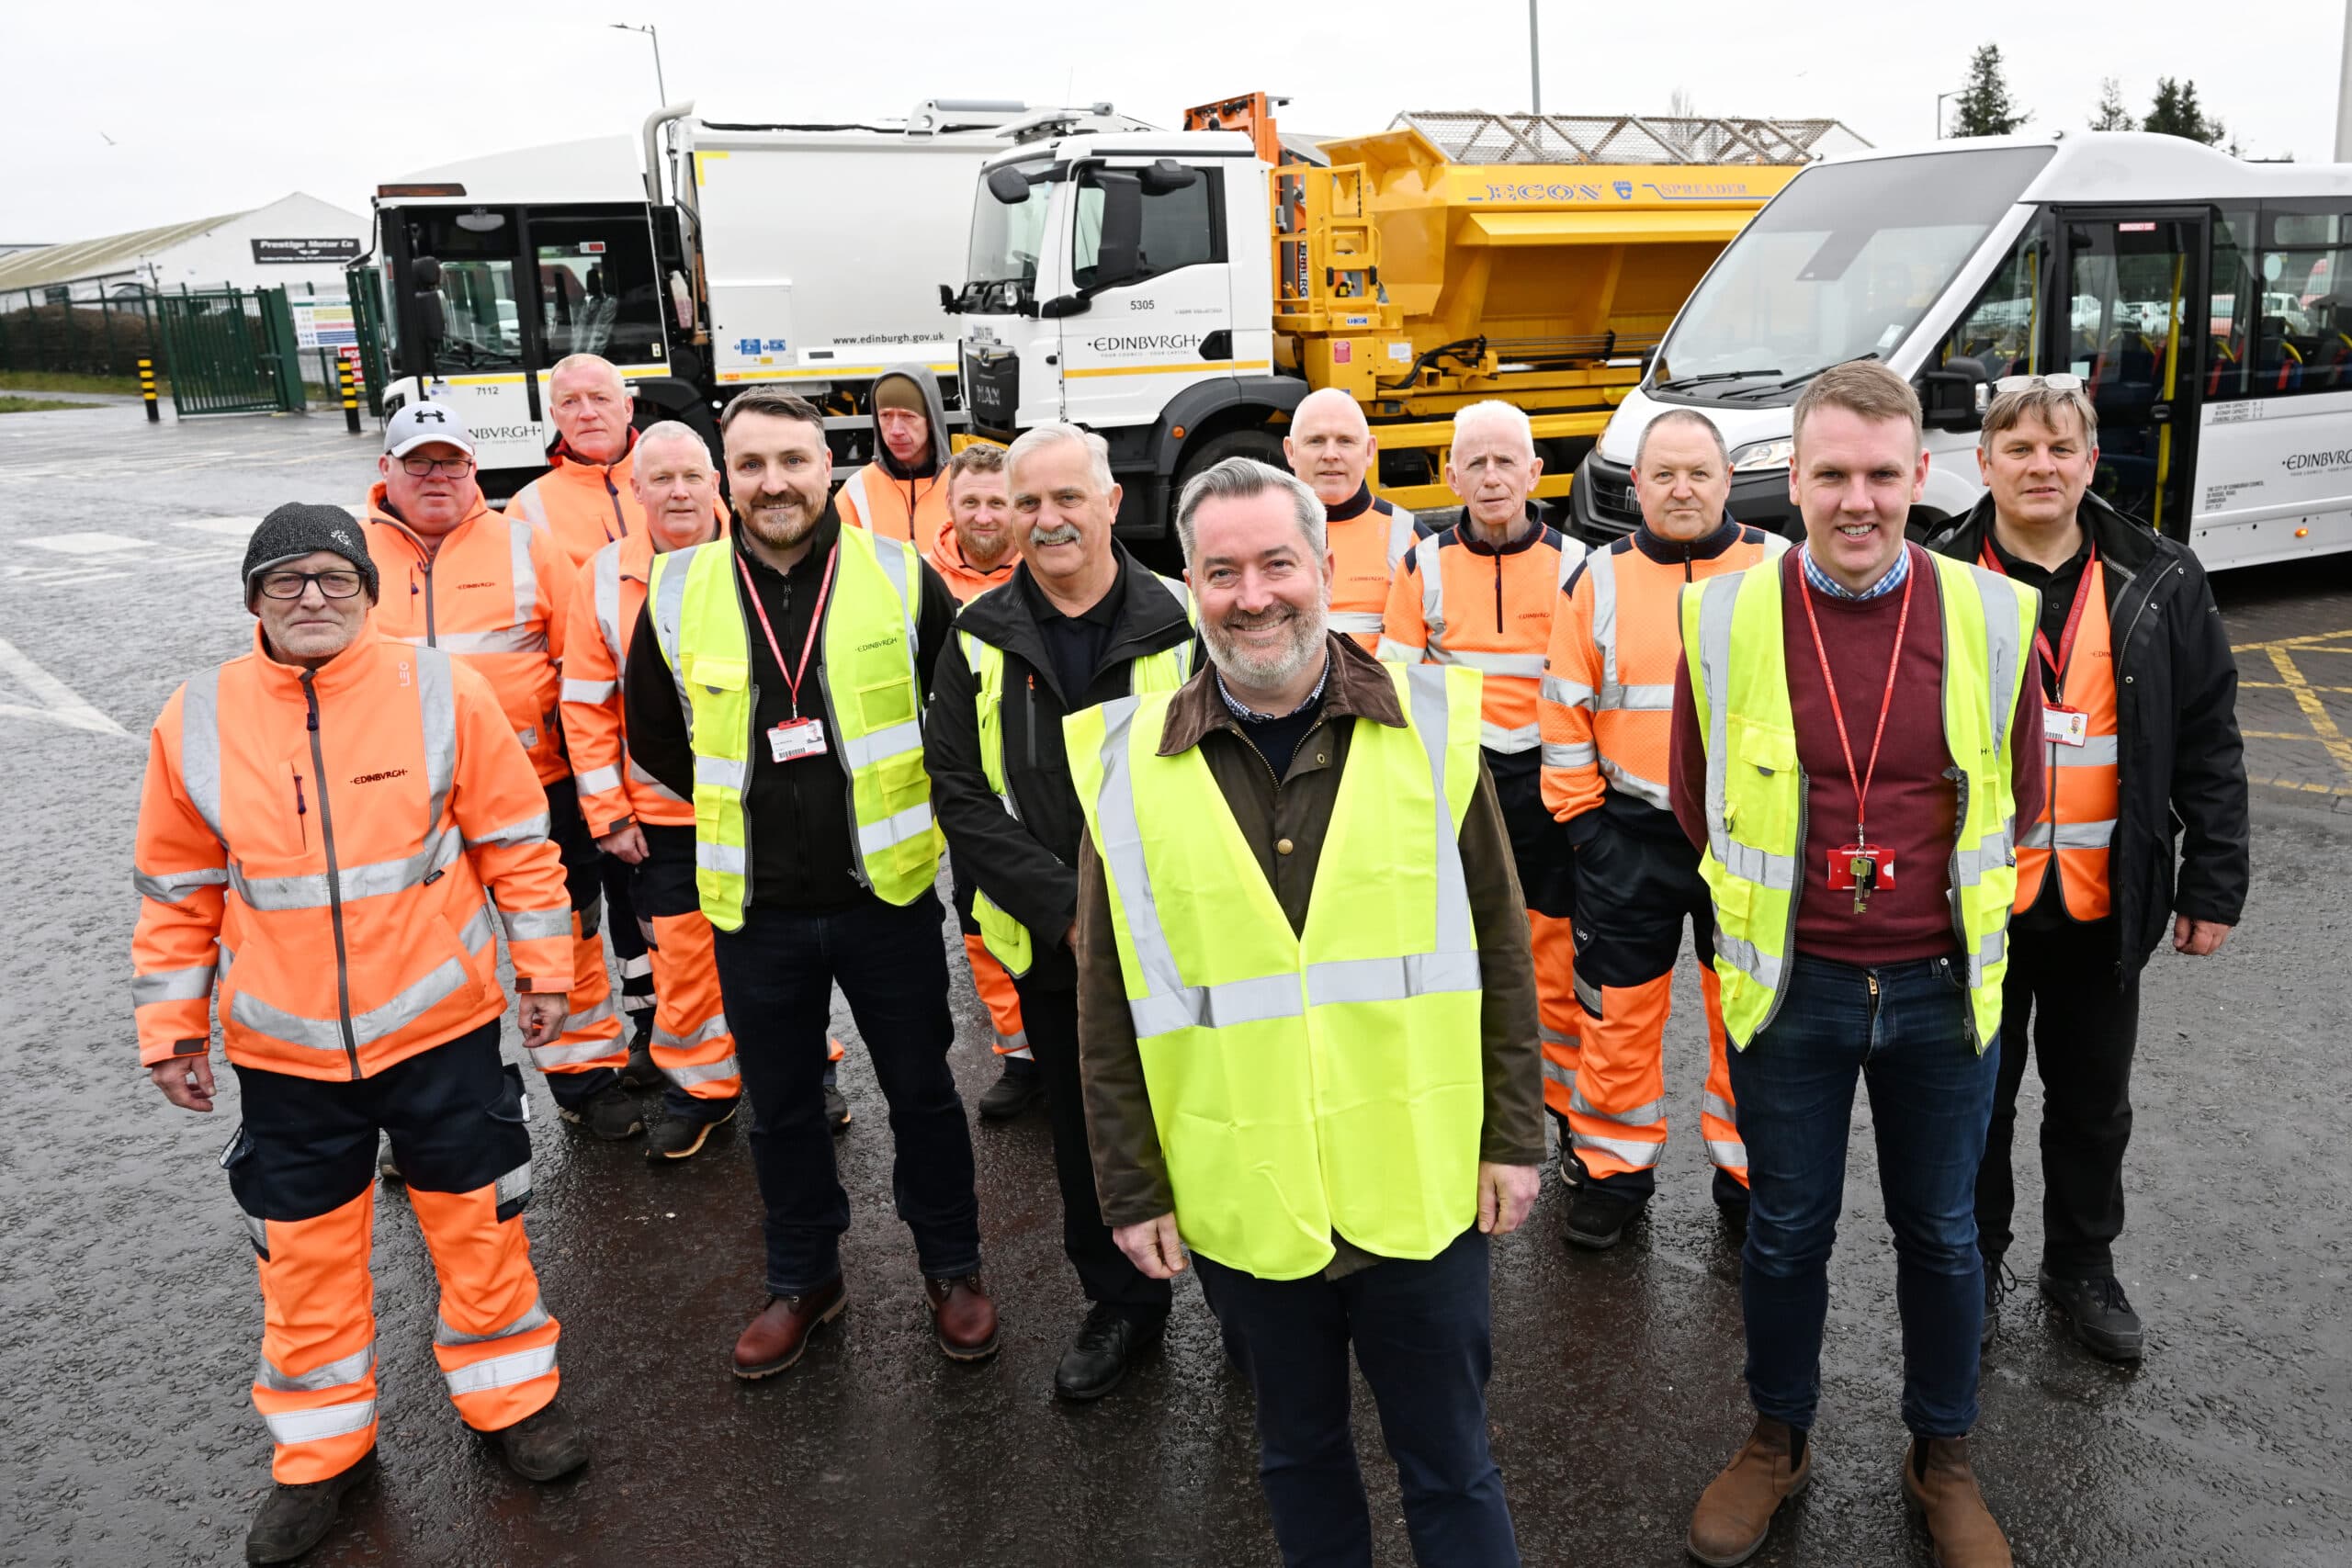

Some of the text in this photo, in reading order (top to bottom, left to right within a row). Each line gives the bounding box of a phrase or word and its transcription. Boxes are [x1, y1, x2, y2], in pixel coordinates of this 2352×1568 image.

[1486, 184, 1747, 200] ECON SPREADER
[260, 241, 306, 250] Prestige
[1299, 242, 1309, 298] ERBERG
[1130, 299, 1155, 310] 5305
[832, 332, 944, 344] www.edinburgh.gov.uk
[477, 387, 500, 395] 7112
[976, 385, 1001, 405] MAN
[468, 425, 536, 439] NBVRGH
[399, 660, 411, 687] LEO
